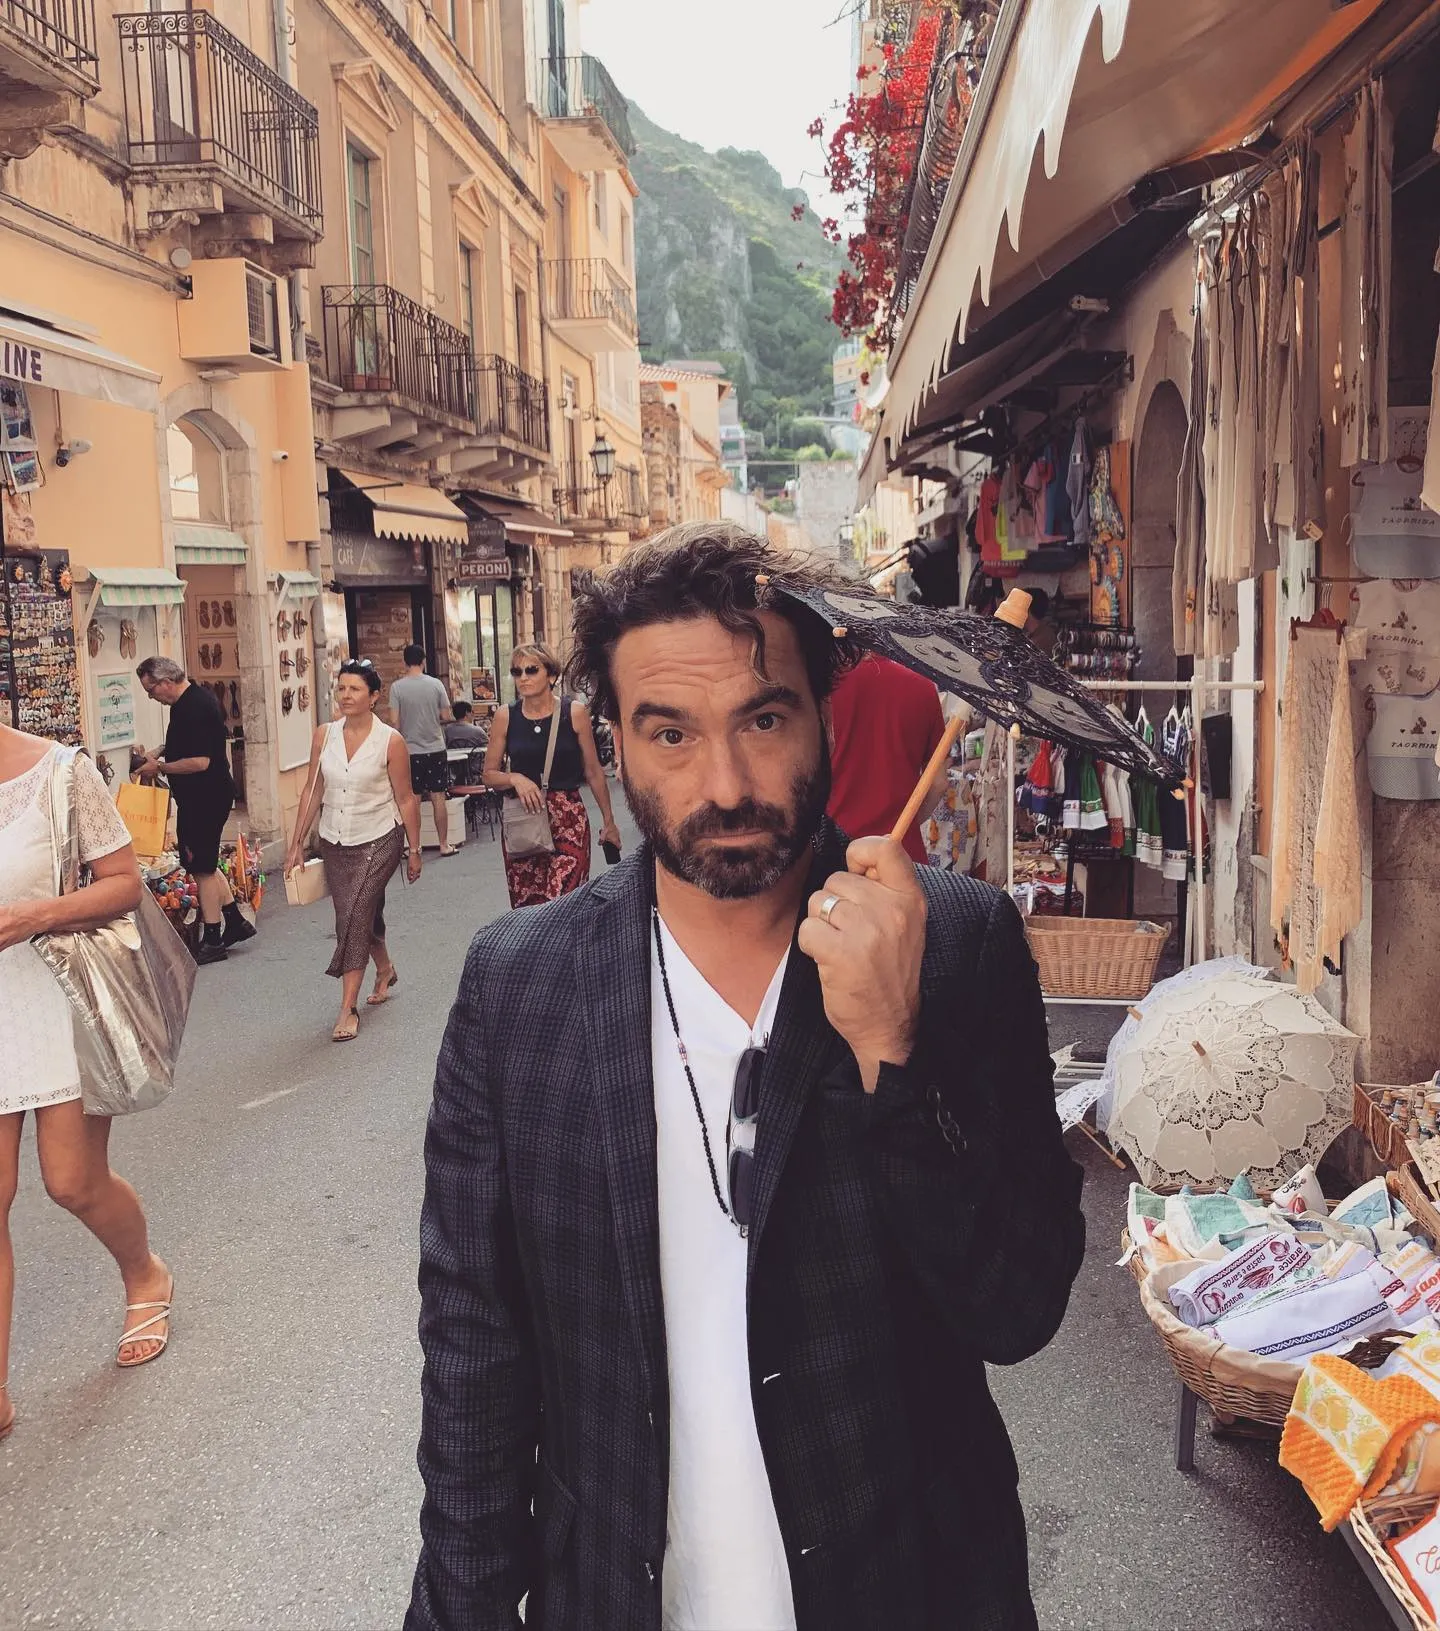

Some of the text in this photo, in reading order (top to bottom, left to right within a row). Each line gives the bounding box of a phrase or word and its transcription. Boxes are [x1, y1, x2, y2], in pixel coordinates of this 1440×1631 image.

[461, 563, 508, 576] PERONI
[1371, 634, 1424, 646] TAORMINA
[1247, 1251, 1266, 1271] pasta
[1278, 1246, 1303, 1272] arance
[1222, 1272, 1243, 1288] sarde
